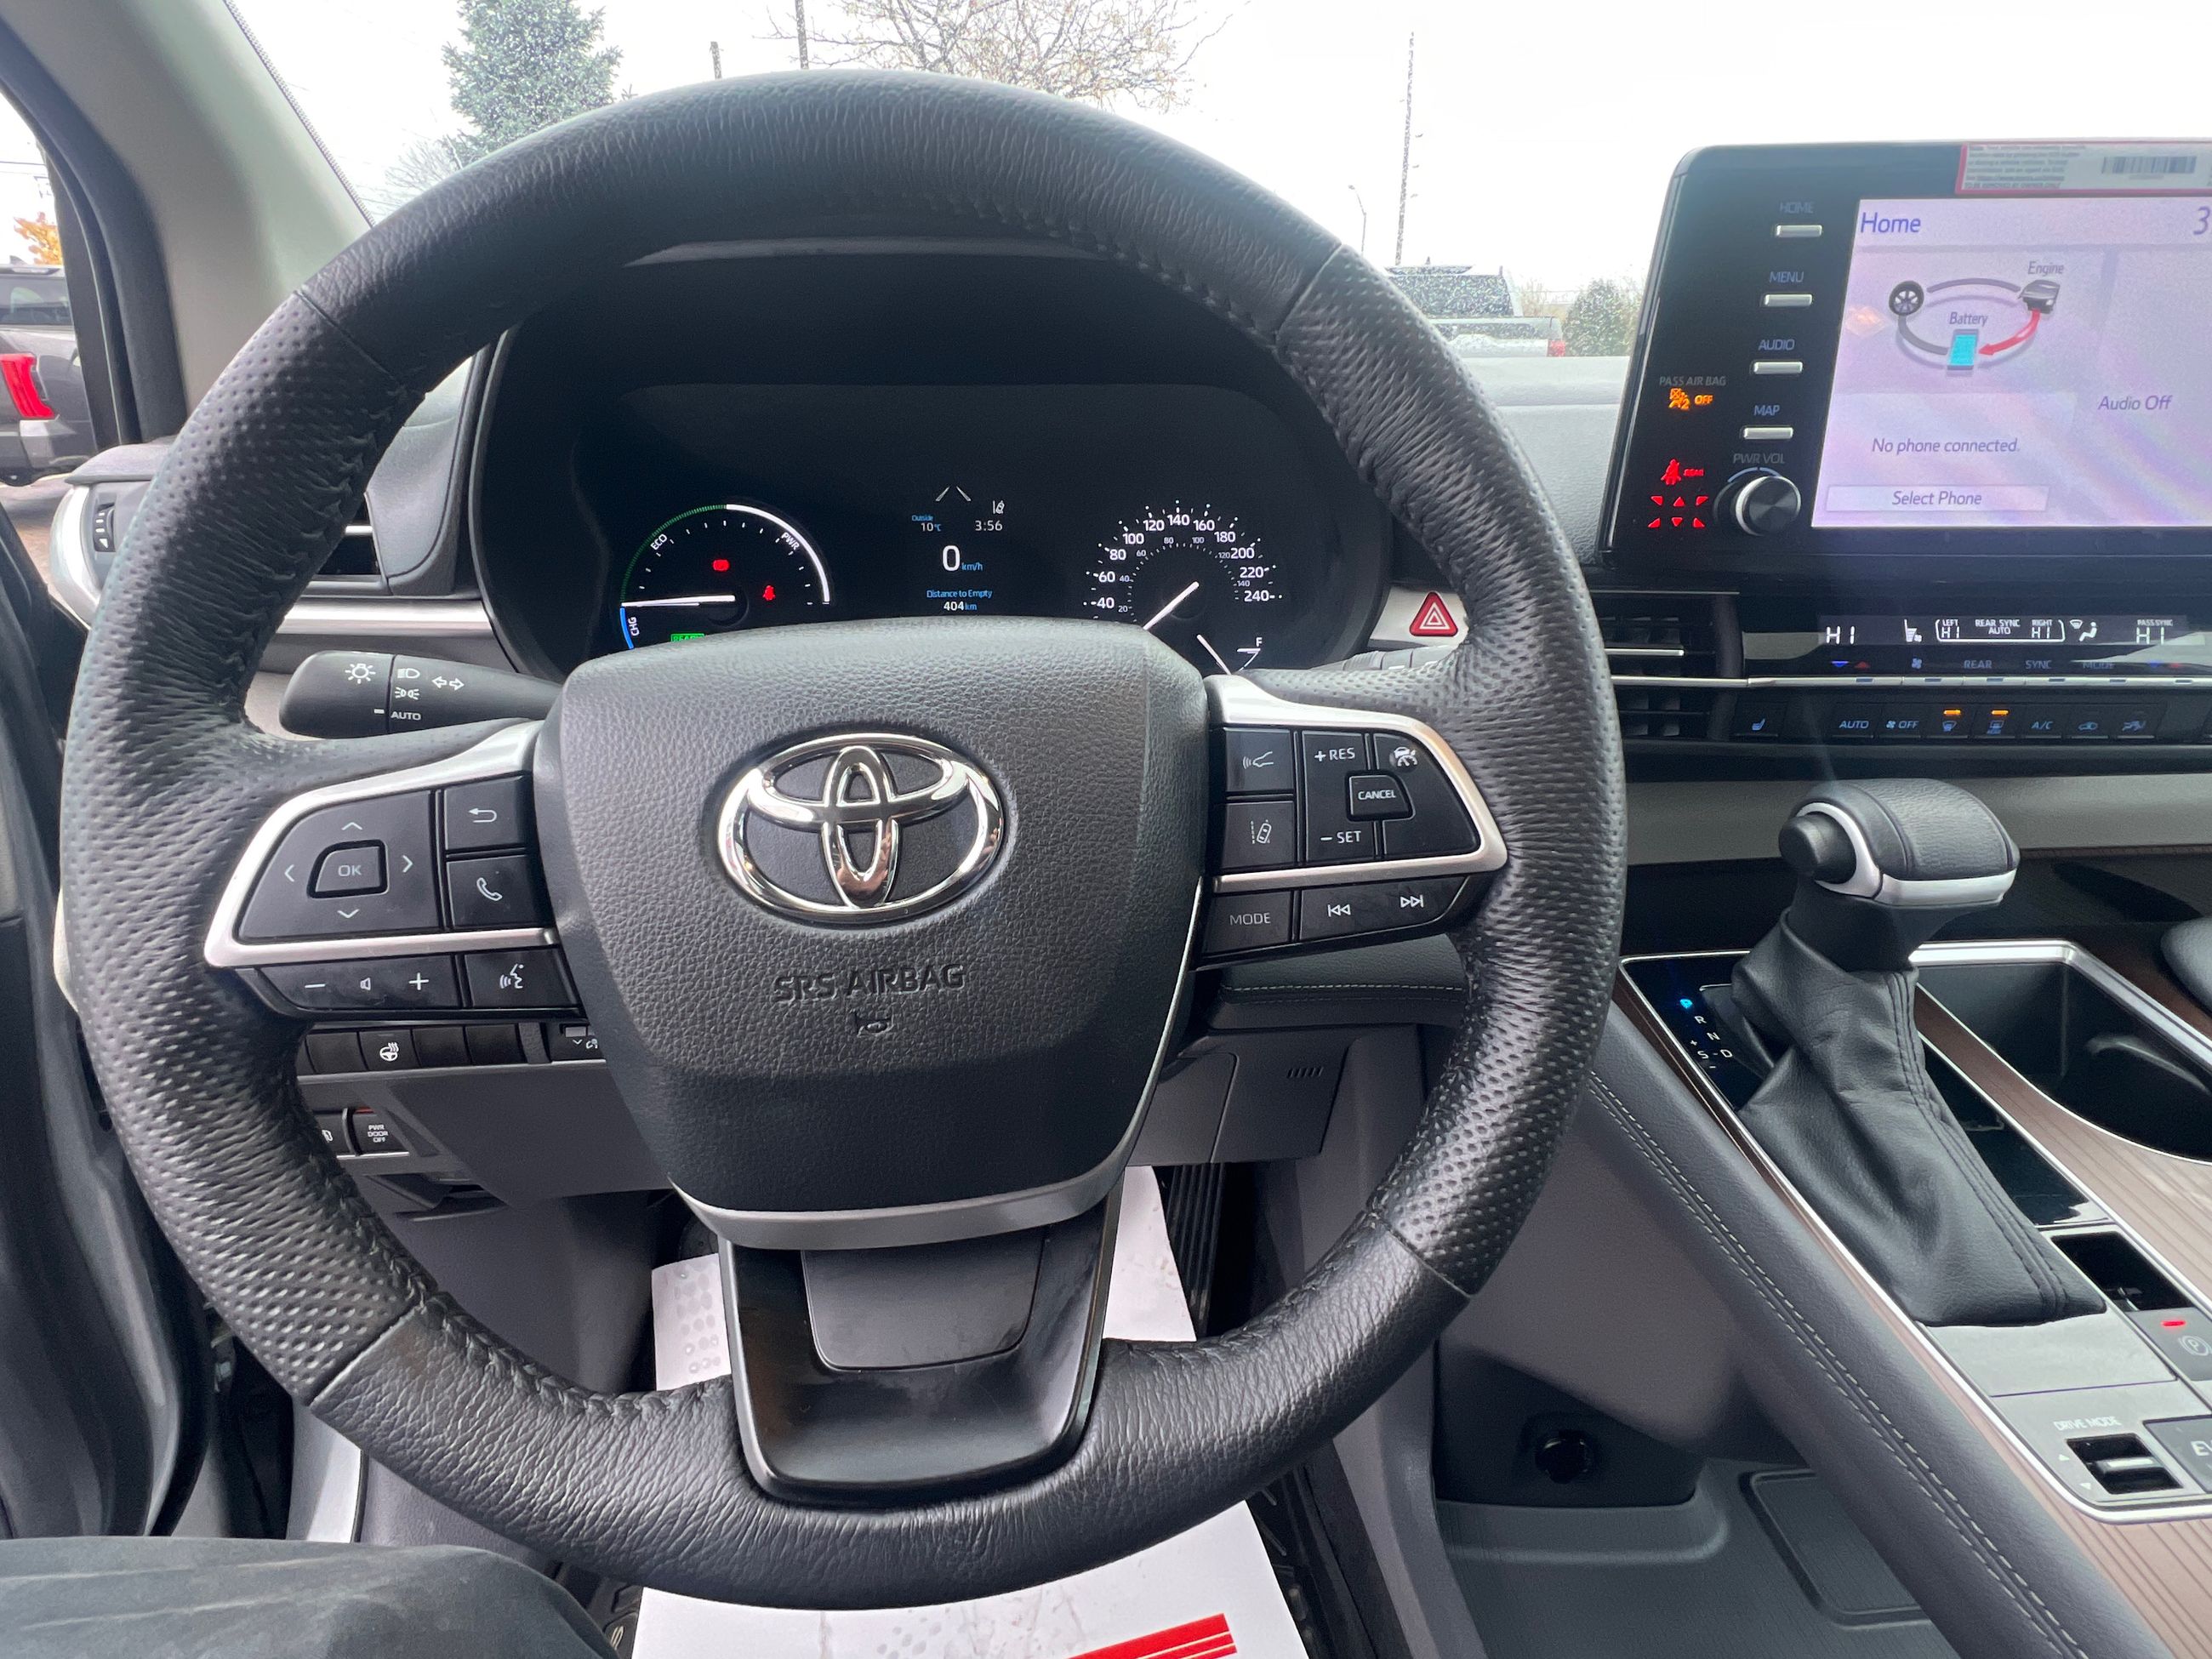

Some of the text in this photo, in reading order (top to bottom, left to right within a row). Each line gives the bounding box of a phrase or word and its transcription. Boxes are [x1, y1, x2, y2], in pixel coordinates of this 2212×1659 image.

[1779, 202, 1815, 214] HOME
[1860, 212, 1922, 234] Home
[2027, 261, 2065, 276] Engine
[1769, 271, 1804, 283] MENU
[1949, 311, 1988, 327] Battery
[1758, 339, 1795, 351] AUDIO
[1659, 376, 1727, 386] PASS AIR BAG
[1694, 395, 1713, 406] OFF
[2097, 395, 2173, 411] Audio Off
[1753, 405, 1781, 416] MAP
[1871, 437, 2021, 456] No phone connected.
[1732, 452, 1786, 465] PWR VOL
[1892, 490, 1982, 505] Select Phone
[975, 520, 1003, 531] 3:56
[1143, 519, 1165, 532] 120
[1167, 514, 1190, 526] 140
[1193, 520, 1216, 532] 160
[650, 533, 669, 551] ECO
[780, 532, 801, 551] PWR
[1122, 533, 1144, 544] 100
[1214, 531, 1236, 543] 180
[942, 544, 983, 571] 0 km/h
[1109, 549, 1127, 561] 80
[1230, 547, 1255, 559] 200
[1098, 571, 1116, 583] 60
[1240, 567, 1264, 579] 220
[926, 589, 993, 599] Distance to Empty
[1244, 590, 1270, 602] 240
[1097, 597, 1115, 609] 40
[628, 616, 640, 636] CHG
[1975, 619, 2021, 627] REAR SYNC
[1826, 625, 1856, 644] HI
[1941, 626, 1960, 638] HI
[2031, 626, 2050, 639] HI
[2135, 626, 2165, 645] HI
[1256, 637, 1263, 647] F
[1964, 659, 1993, 670] REAR
[2025, 659, 2052, 670] SYNC
[391, 710, 421, 721] AUTO
[1839, 720, 1870, 729] AUTO
[1897, 720, 1920, 729] OFF
[2031, 721, 2053, 730] A/C
[1358, 790, 1396, 801] CANCEL
[338, 864, 362, 876] OK
[1229, 912, 1271, 926] MODE
[773, 963, 966, 1002] SRS AIRBAG
[1694, 1015, 1707, 1024] R
[1706, 1032, 1721, 1040] N
[1719, 1049, 1733, 1058] D
[2053, 1416, 2123, 1430] DRIVE MODE
